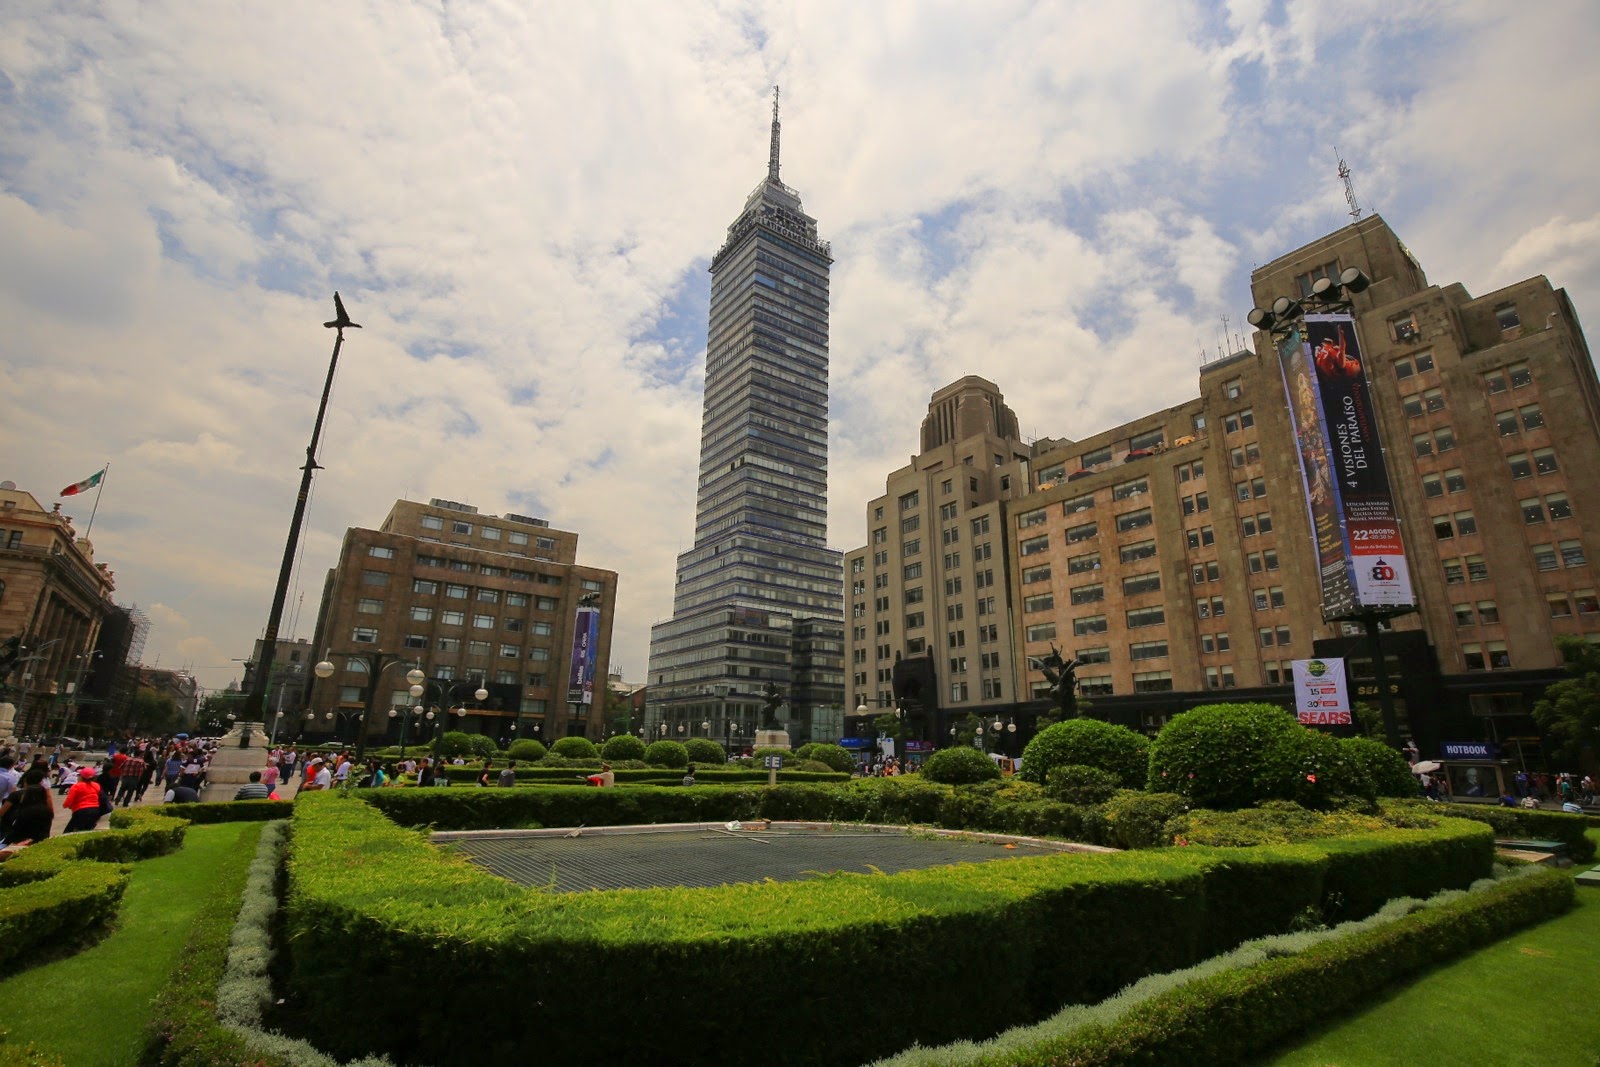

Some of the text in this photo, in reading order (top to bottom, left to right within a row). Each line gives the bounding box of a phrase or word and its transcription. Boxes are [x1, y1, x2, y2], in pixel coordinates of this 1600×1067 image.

[762, 218, 828, 256] LATINOAMERICANA
[1342, 395, 1361, 443] PARAÍSO
[1336, 423, 1356, 477] VISIONES
[1353, 447, 1368, 469] DEL
[1353, 530, 1369, 540] 22
[1310, 688, 1320, 696] 15
[1358, 684, 1399, 695] SEAS
[1299, 711, 1351, 724] SEARS
[1446, 745, 1488, 755] HOTBOOK
[772, 756, 780, 768] E
